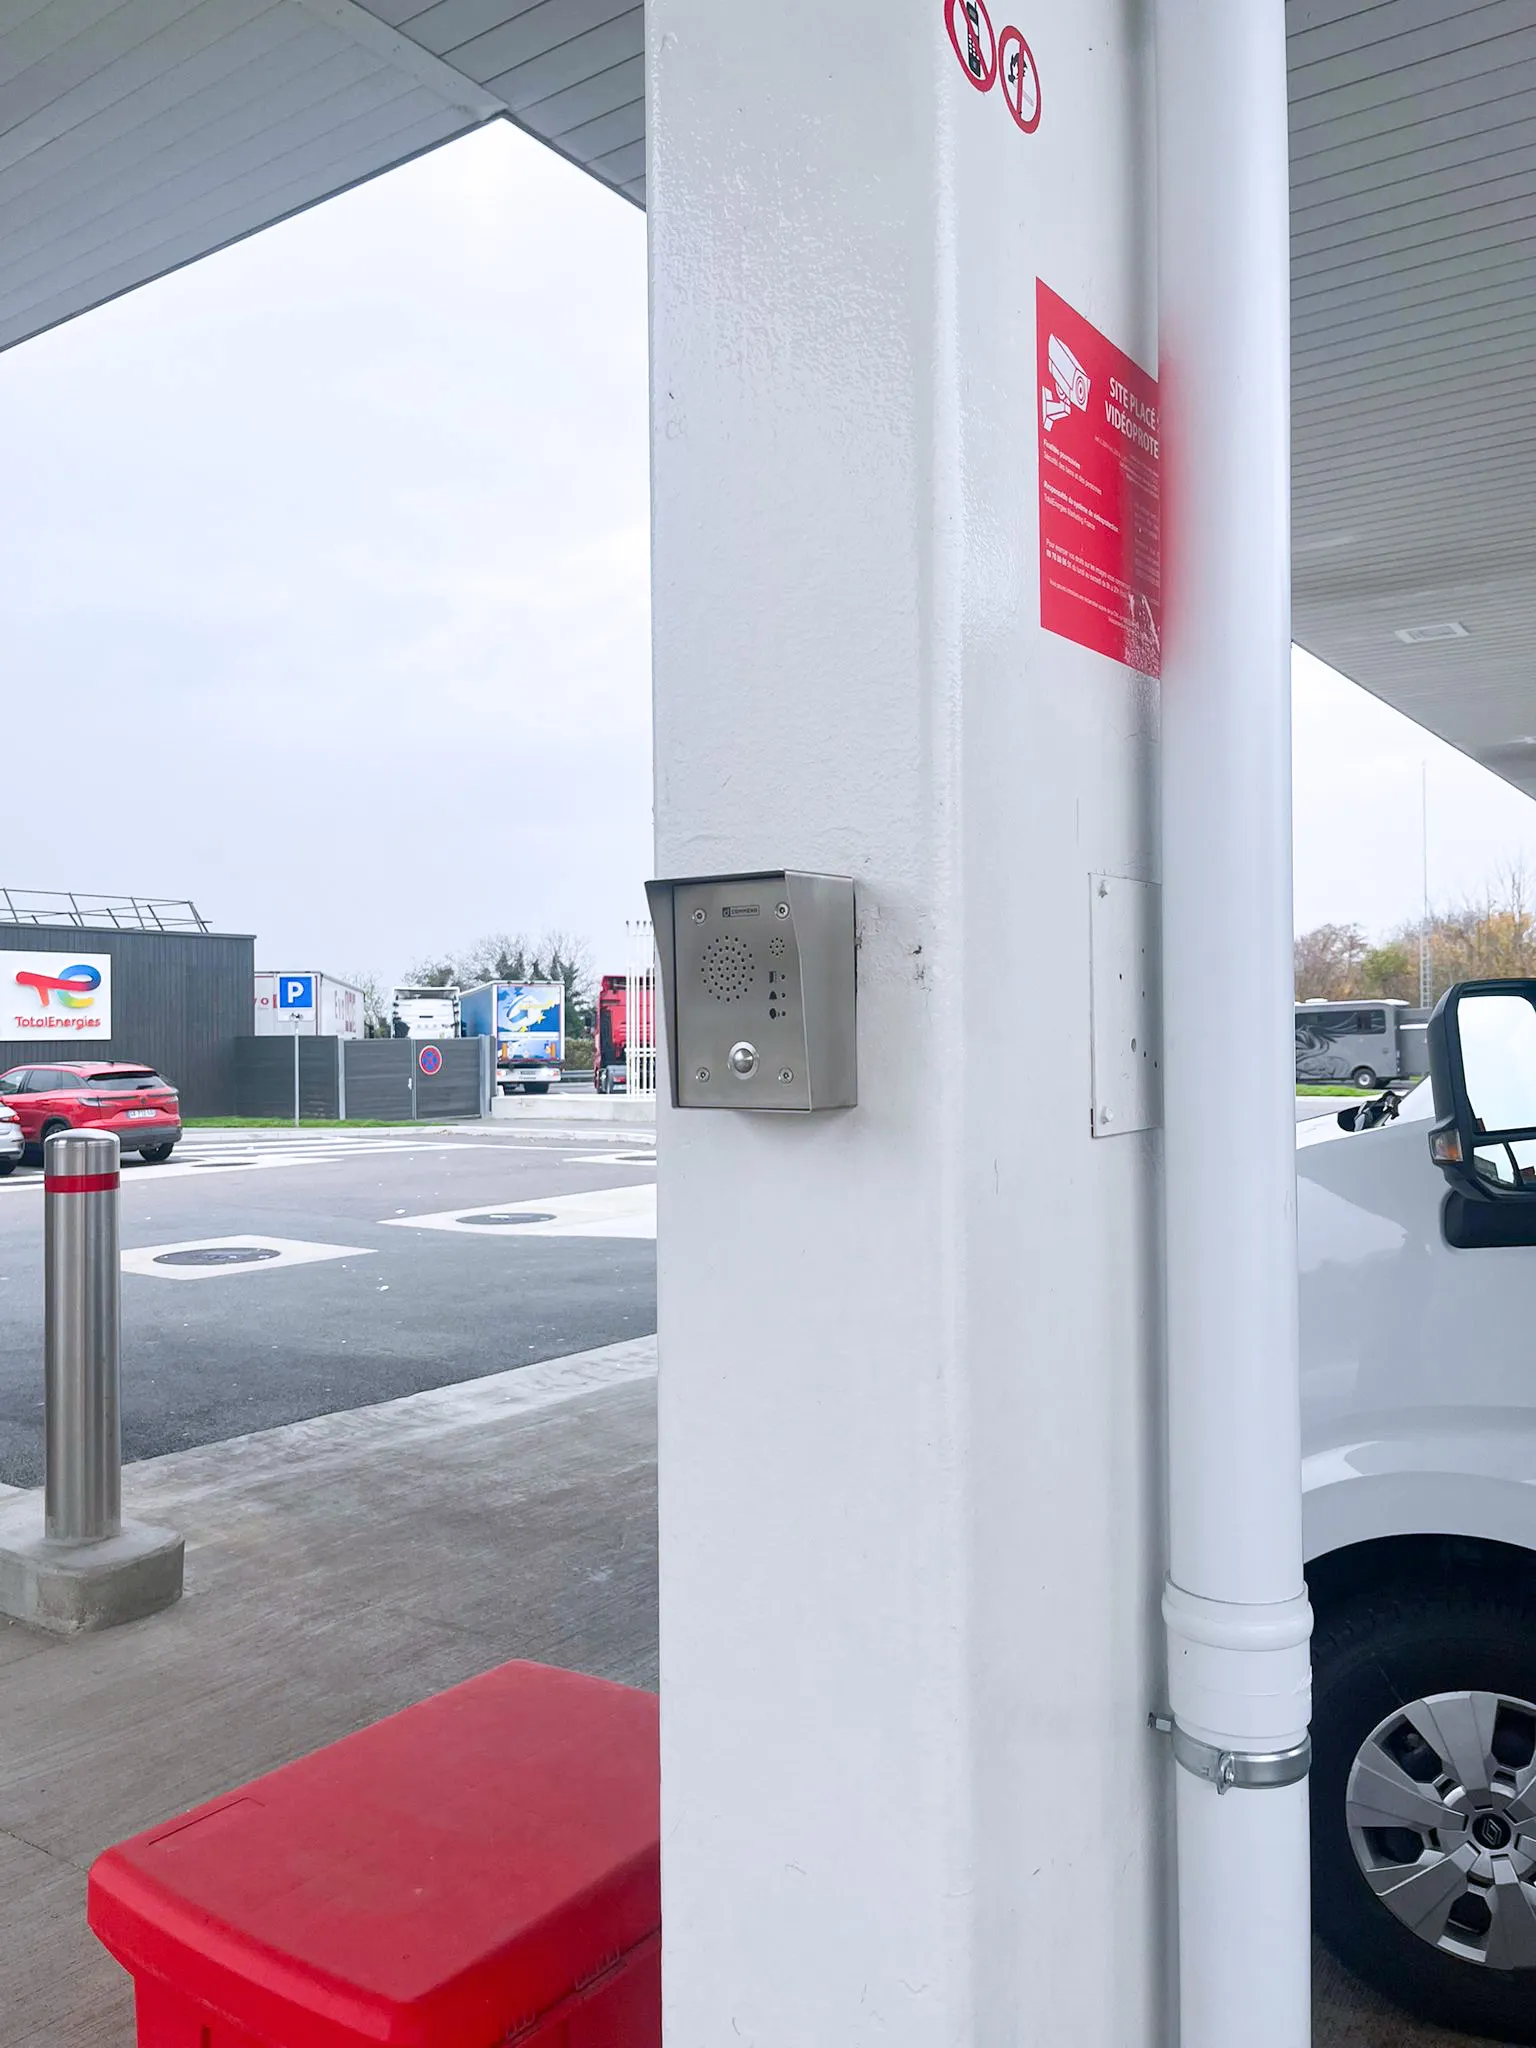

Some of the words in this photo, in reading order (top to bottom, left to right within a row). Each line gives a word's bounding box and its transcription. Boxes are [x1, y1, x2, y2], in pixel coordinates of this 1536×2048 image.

[1110, 377, 1128, 408] SITE
[1130, 393, 1156, 431] PLACÉ
[1105, 401, 1159, 460] VIDÉOPROTE
[287, 981, 305, 1004] P
[14, 1016, 101, 1030] TotalEnergies
